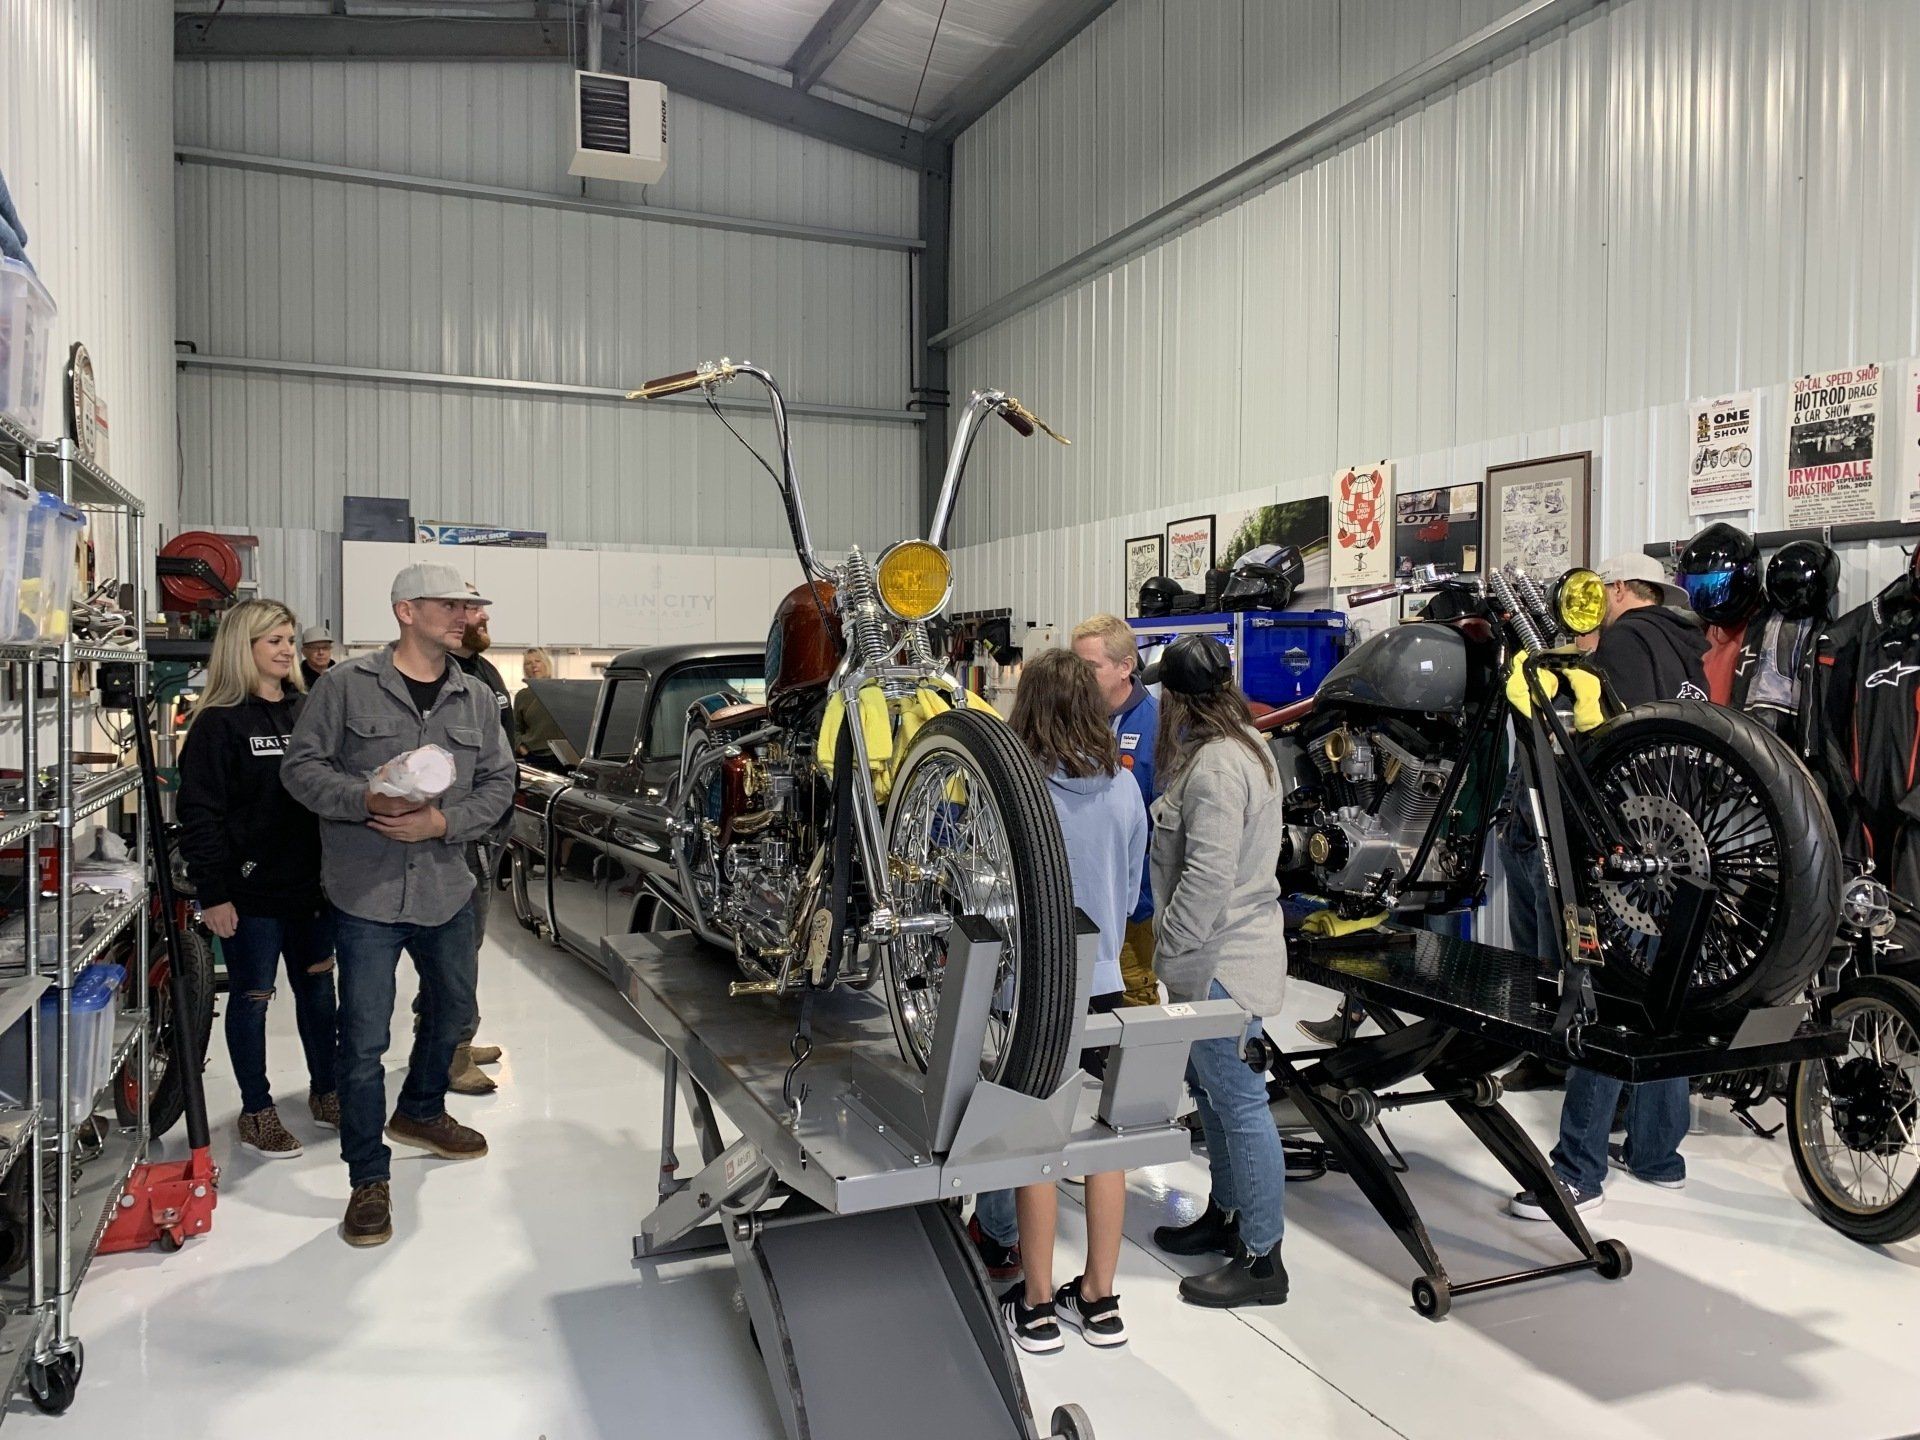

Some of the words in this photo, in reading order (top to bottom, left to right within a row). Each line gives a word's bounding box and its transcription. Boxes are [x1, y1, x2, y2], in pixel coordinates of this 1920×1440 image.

[1794, 377, 1822, 394] SO-CAL
[1826, 372, 1853, 388] SPEED
[1856, 366, 1880, 383] SHOP
[1794, 386, 1846, 412] HOTROD
[1848, 382, 1878, 400] DRAGS
[1713, 408, 1750, 424] ONE
[1794, 412, 1801, 424] &
[1804, 408, 1821, 423] CAR
[1825, 403, 1852, 420] SHOW
[1714, 426, 1749, 439] SHOW
[1789, 460, 1872, 485] IRWINDALE
[1836, 473, 1873, 485] SEPTEMBER
[1788, 480, 1836, 498] DRAGSTRIP
[1854, 481, 1872, 489] 2002
[1132, 543, 1156, 556] HUNTER
[663, 594, 715, 610] CITY
